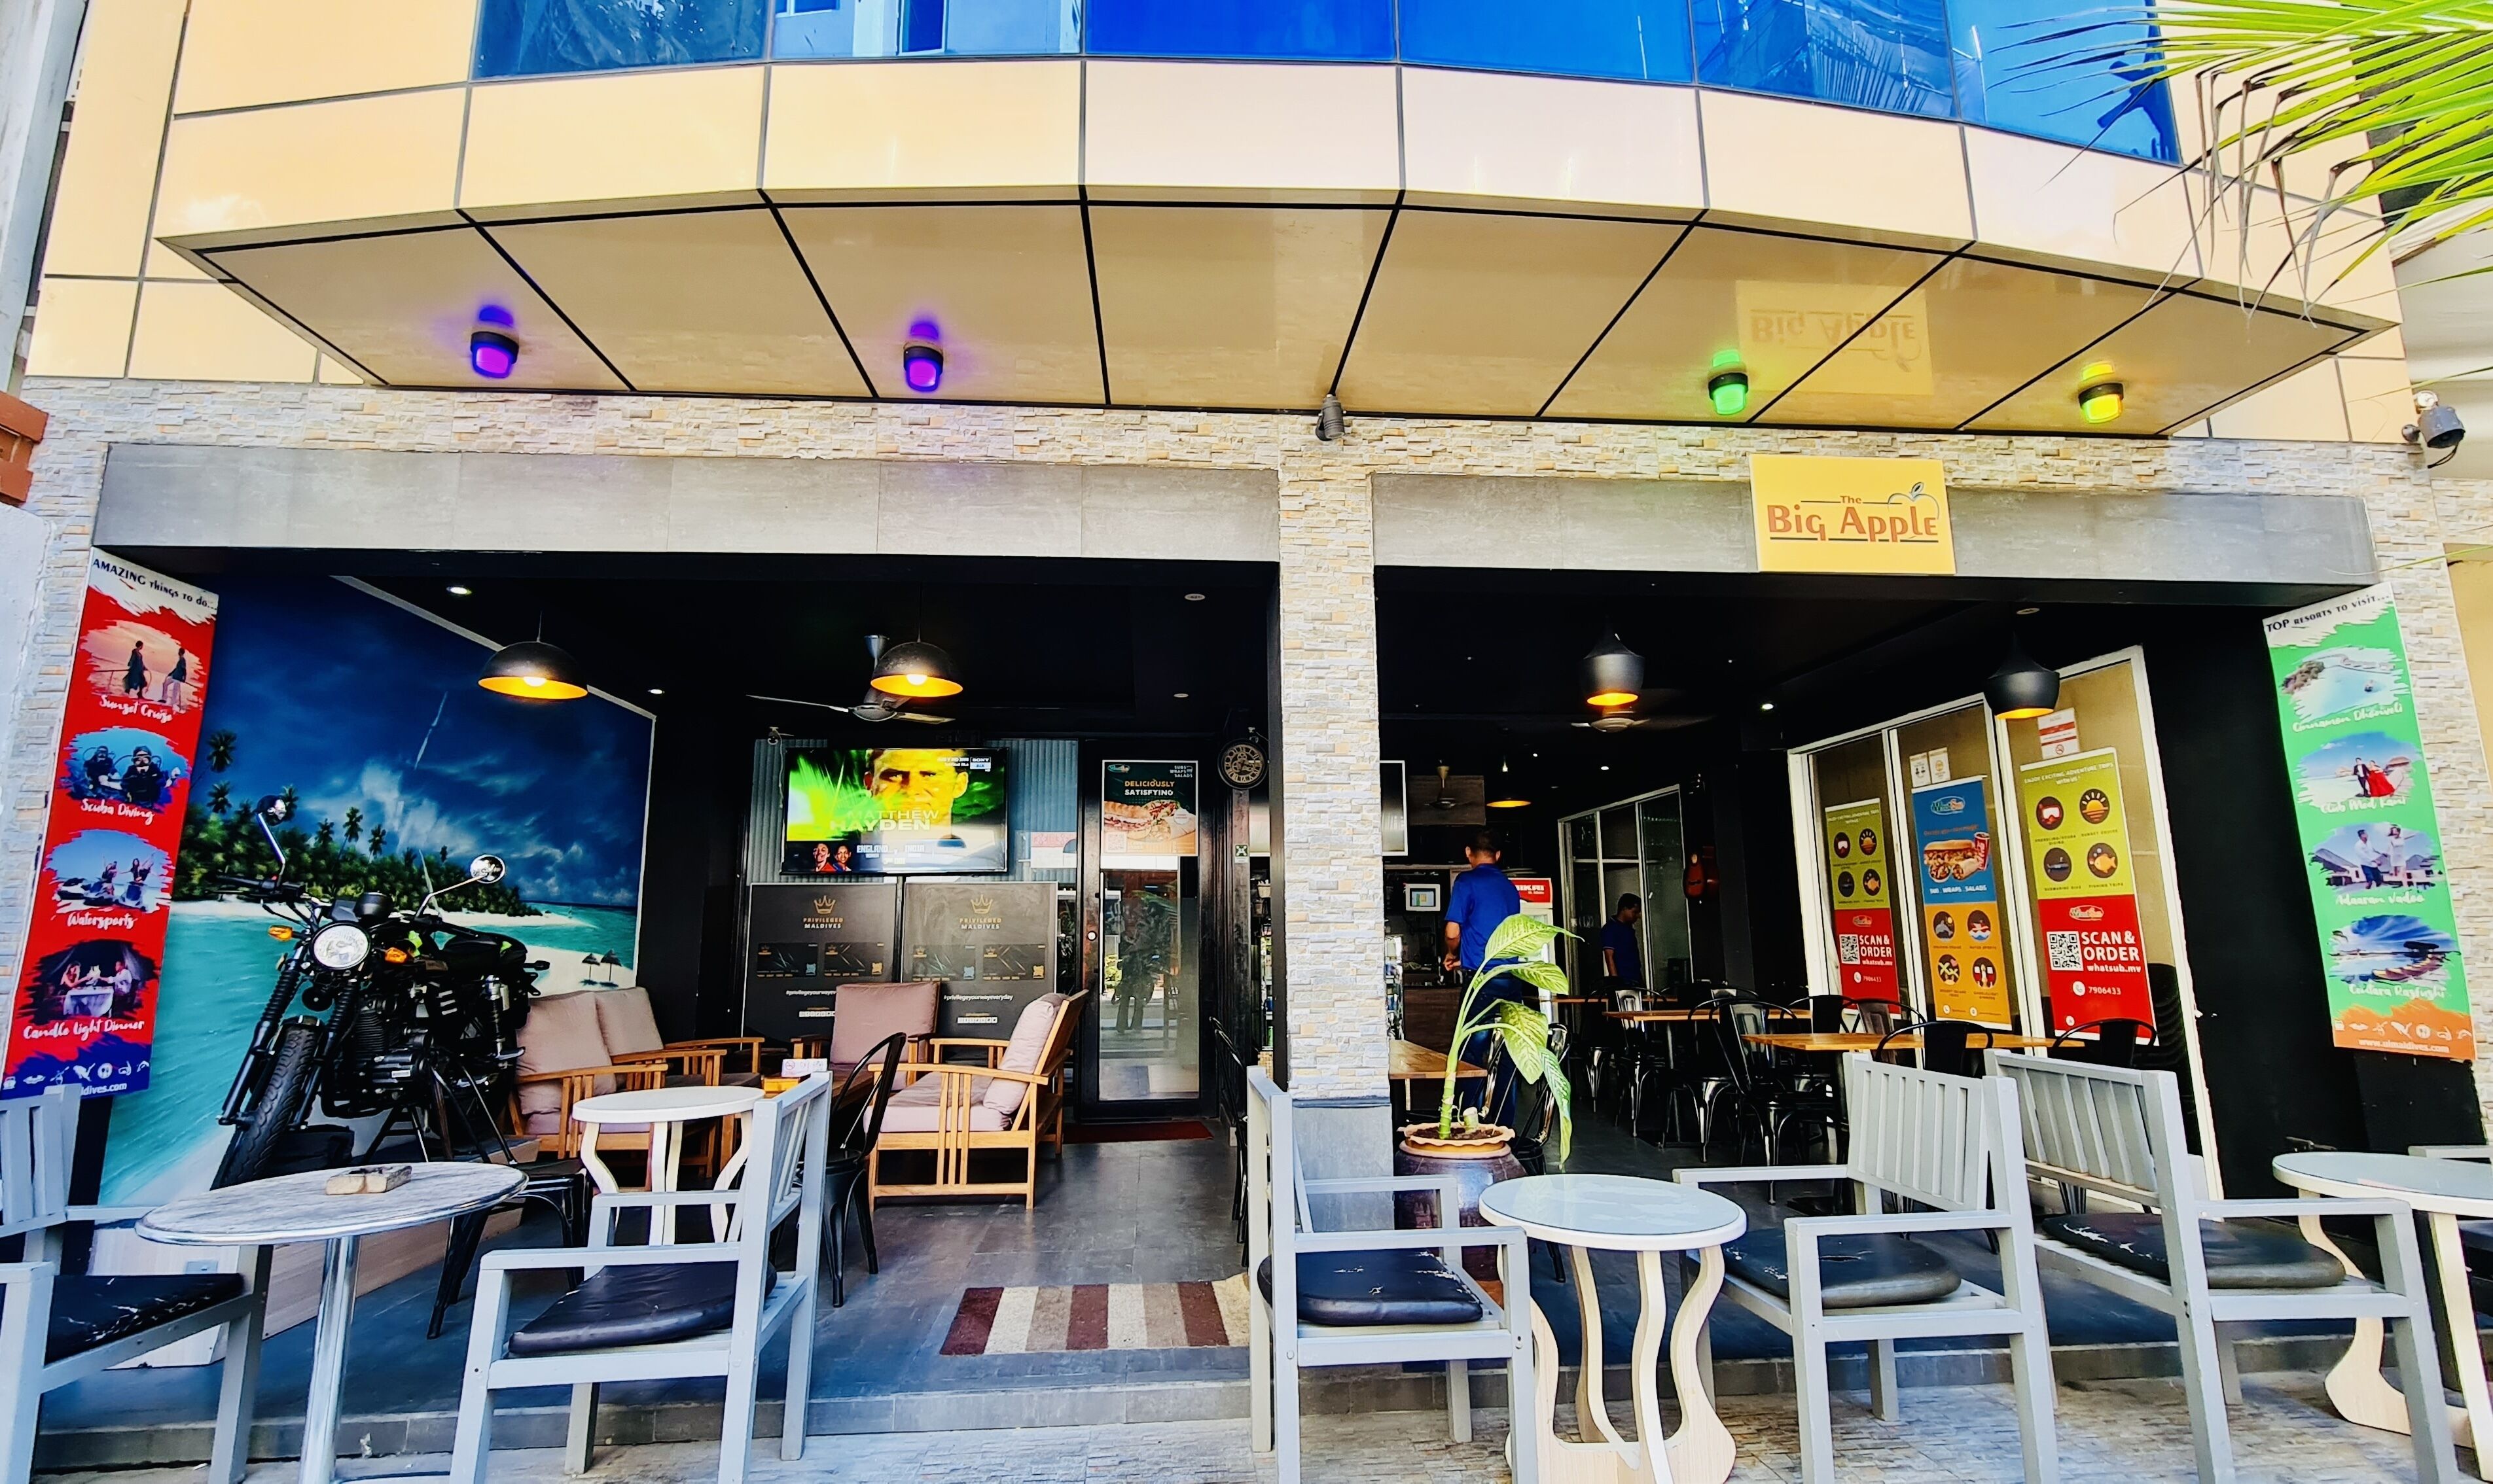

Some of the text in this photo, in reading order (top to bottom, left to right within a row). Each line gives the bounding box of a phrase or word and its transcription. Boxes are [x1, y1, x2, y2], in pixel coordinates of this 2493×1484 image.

[1840, 495, 1861, 504] The
[1767, 504, 1938, 542] Big Apple
[93, 558, 146, 586] AMAZING
[2266, 619, 2289, 633] TOP
[99, 694, 173, 724] Sunset Cruise
[81, 798, 154, 825] Scuba Diving
[848, 810, 939, 819] MATTHEW
[830, 819, 931, 831] HAYDEN
[67, 911, 139, 930] Watersports
[1859, 935, 1882, 945] SCAN
[2081, 931, 2122, 945] SCAN
[1860, 946, 1892, 957] ORDER
[2083, 946, 2140, 961] ORDER
[2087, 963, 2142, 973] whatsub.mv
[2089, 986, 2121, 995] 7906433
[23, 1022, 70, 1039] Candle
[104, 1019, 145, 1032] Dinner
